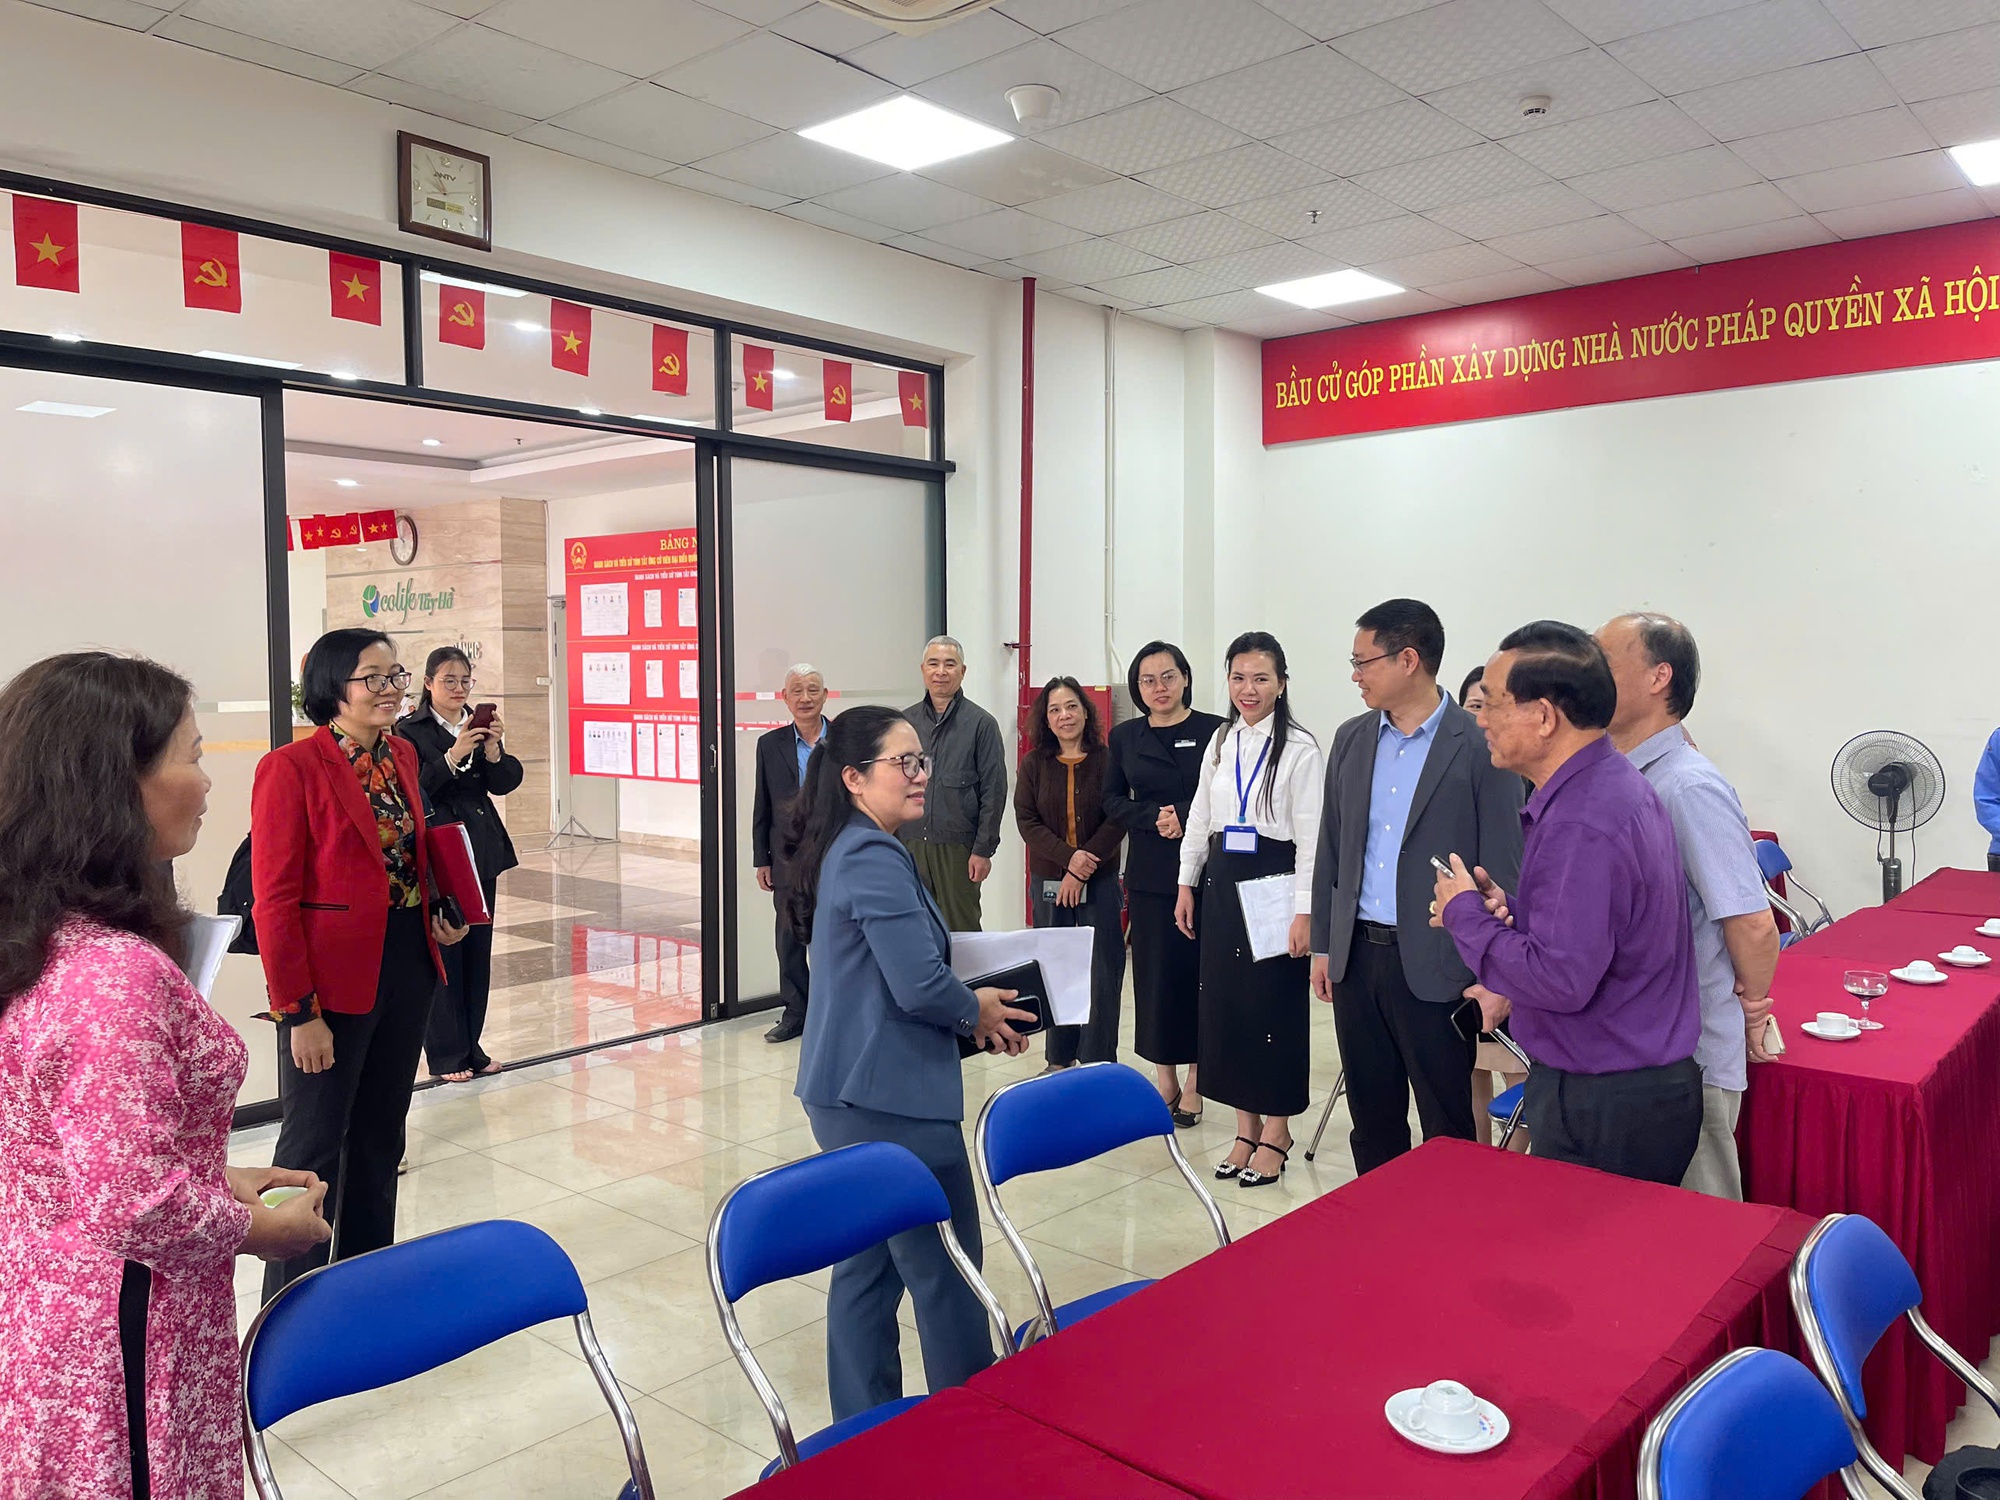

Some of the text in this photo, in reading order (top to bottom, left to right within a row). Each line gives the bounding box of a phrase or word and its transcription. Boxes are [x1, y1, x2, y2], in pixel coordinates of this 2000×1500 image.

[1276, 265, 2000, 408] BẦU CỬ GÓP PHẦN XÂY DỰNG NHÀ NƯỚC PHÁP QUYỀN XÃ HỘI
[660, 533, 689, 550] BẢNG
